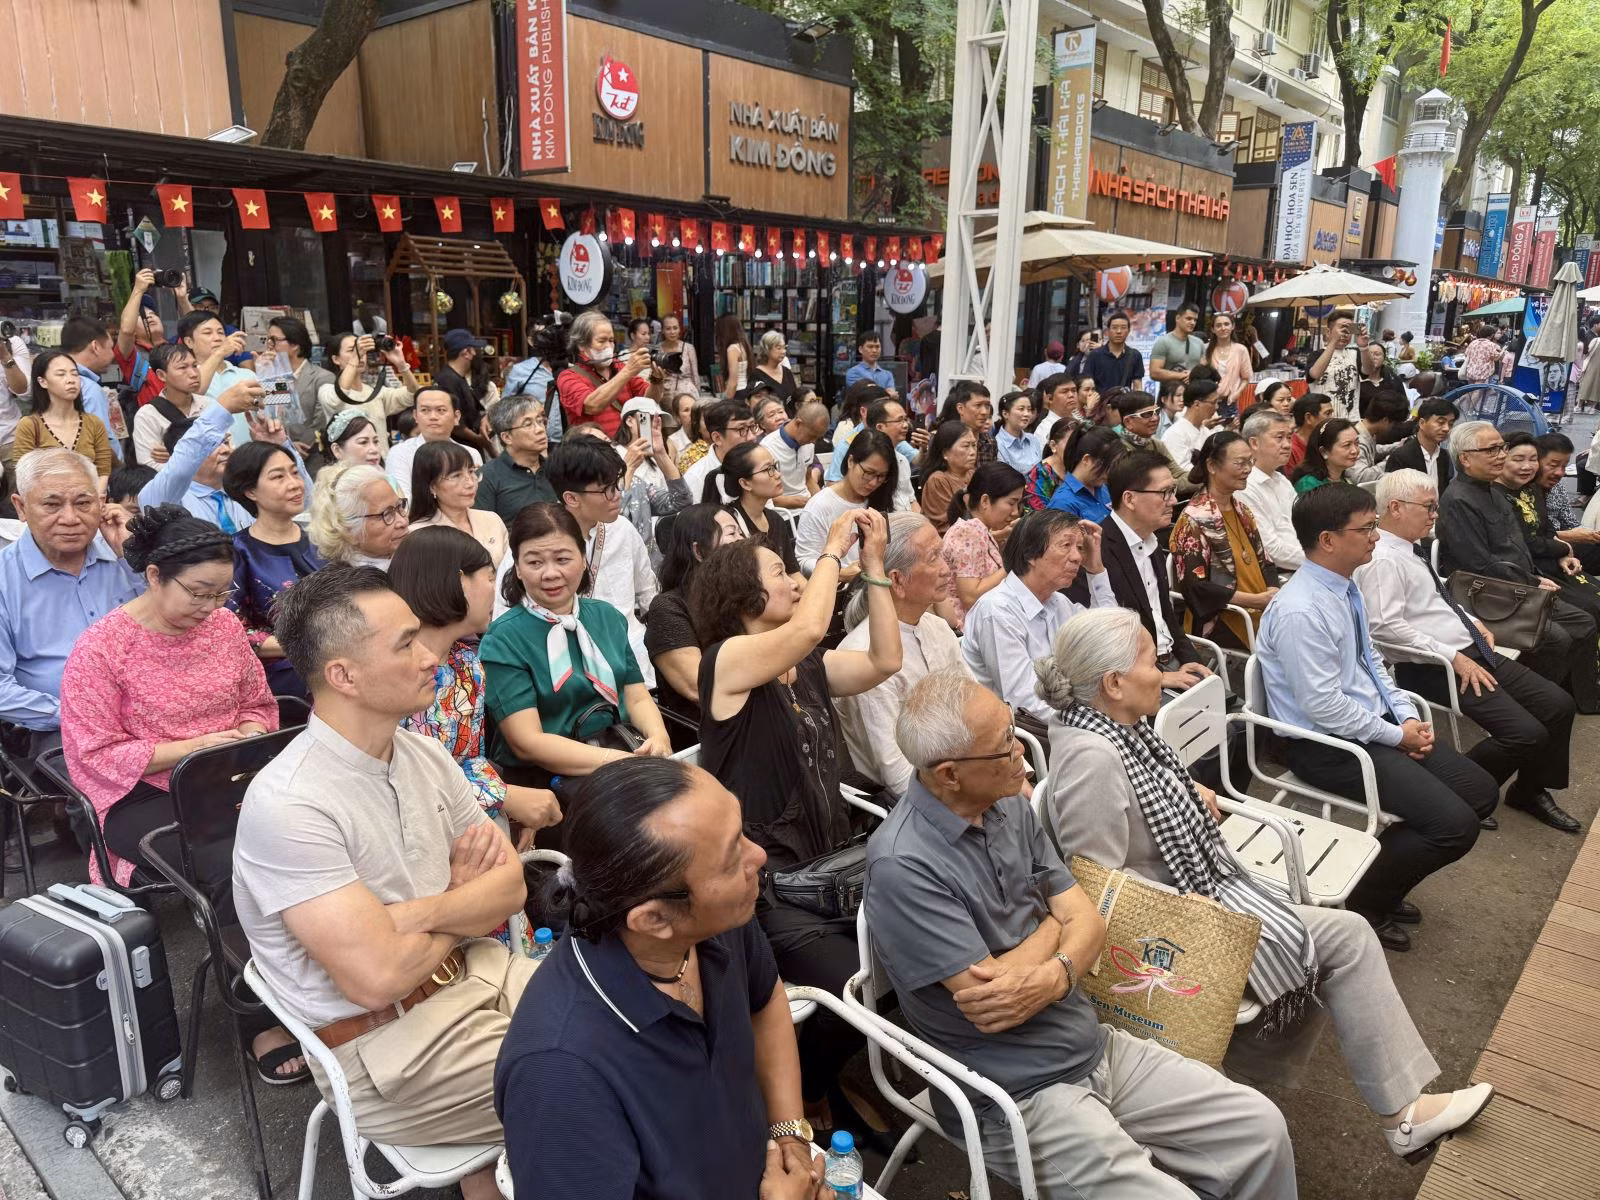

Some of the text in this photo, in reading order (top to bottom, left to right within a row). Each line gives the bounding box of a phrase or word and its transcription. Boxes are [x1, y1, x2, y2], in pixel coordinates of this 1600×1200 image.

[526, 17, 539, 58] BẢN
[527, 64, 540, 113] XUẤT
[543, 68, 554, 124] DONG
[529, 117, 542, 160] NHÀ
[730, 101, 839, 142] NHÀ XUẤT BẢN
[545, 129, 555, 159] KIM
[730, 134, 837, 178] KIM ĐỒNG
[1072, 94, 1085, 200] THAIHABOOKS
[1095, 166, 1231, 221] NHÀ SÁCH THÁI HÀ
[1283, 172, 1298, 260] ĐẠI HỌC HOA SEN
[1090, 994, 1110, 1010] Sen
[1112, 1004, 1165, 1031] Museum
